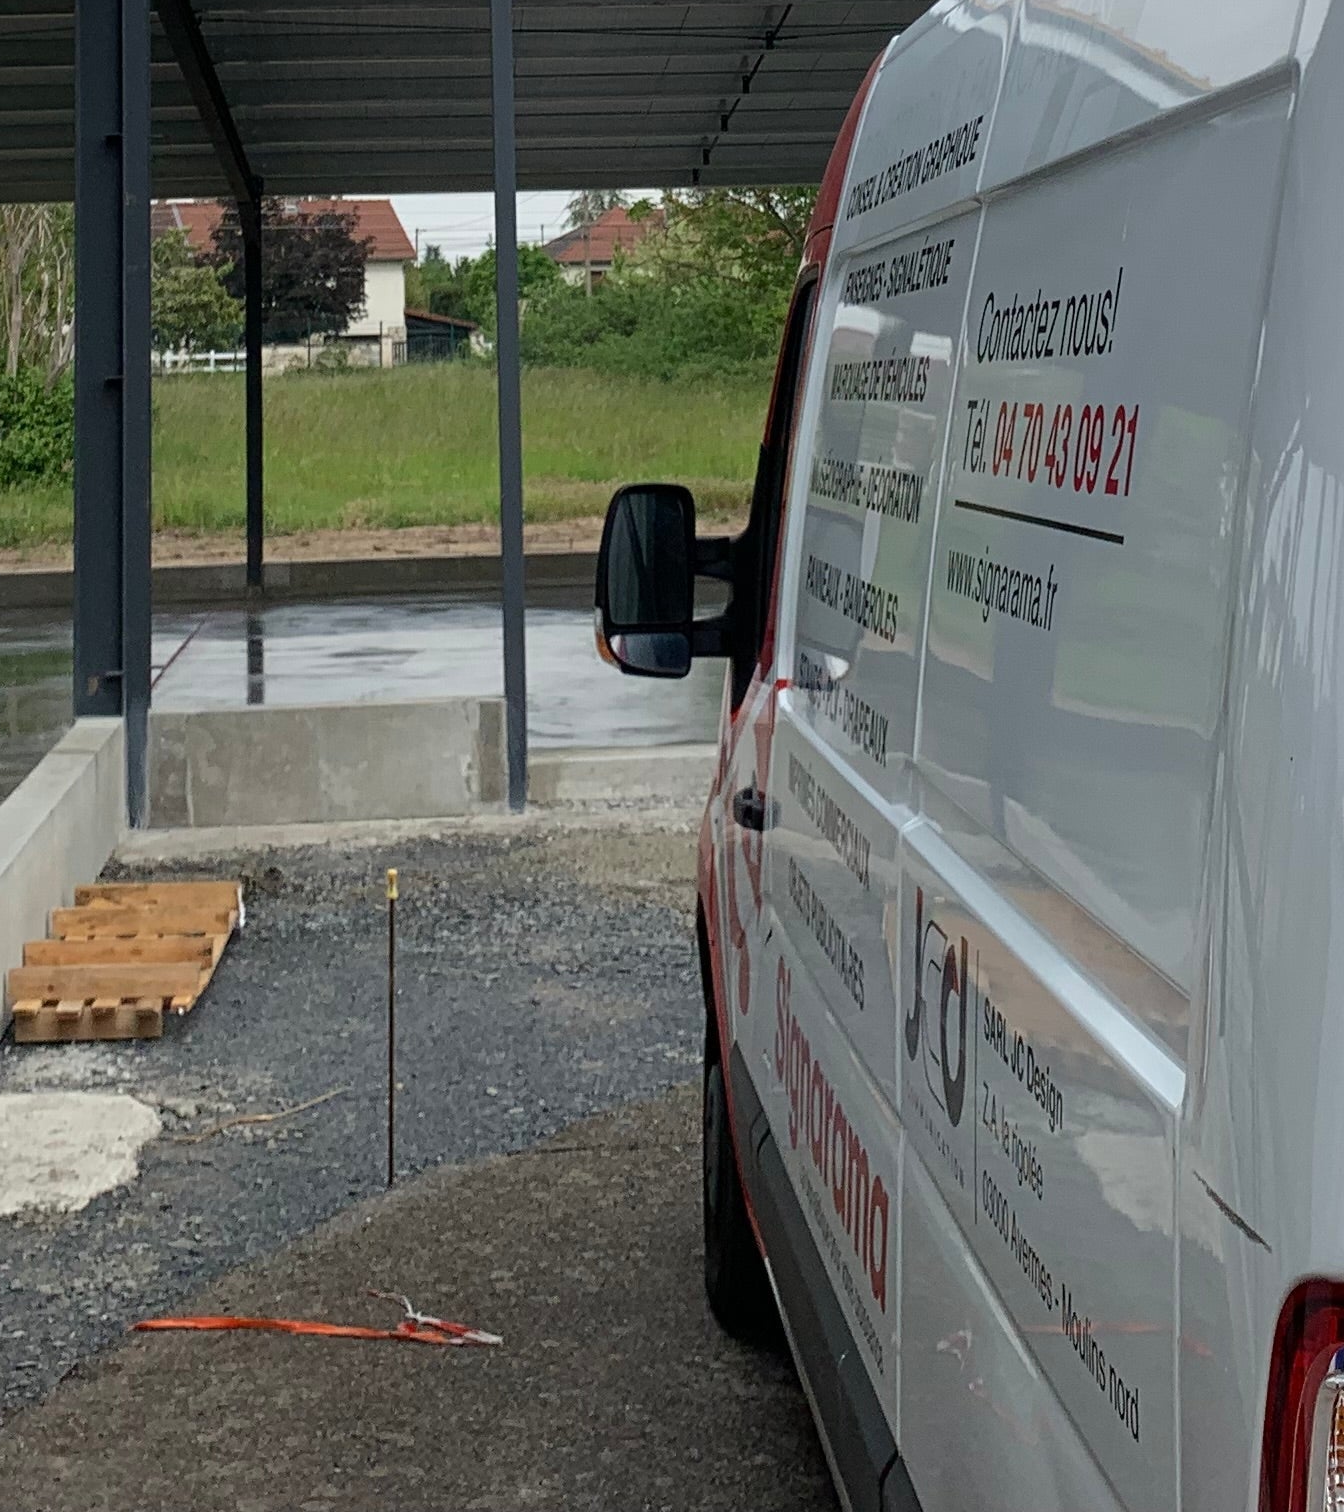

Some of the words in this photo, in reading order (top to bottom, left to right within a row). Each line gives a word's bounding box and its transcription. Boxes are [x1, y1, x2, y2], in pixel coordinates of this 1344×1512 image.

[878, 141, 927, 203] CRÉATION
[918, 114, 983, 185] GRAPHIQUE
[886, 235, 955, 298] SIGNALÉTIQUE
[977, 288, 1060, 364] Contactez
[1060, 266, 1123, 356] nous!
[867, 360, 882, 400] DE
[880, 350, 931, 401] VÉHICULES
[865, 461, 924, 525] DÉCORATION
[963, 398, 991, 473] Tél.
[992, 401, 1018, 477] 04
[1017, 402, 1043, 483] 70
[1044, 404, 1072, 489] 43
[1073, 404, 1105, 495] 09
[1104, 404, 1140, 497] 21
[843, 573, 898, 644] BANDEROLES
[946, 545, 1058, 631] www.signarama.fr
[984, 997, 1009, 1065] SARL
[1011, 1030, 1025, 1082] JC
[1027, 1046, 1063, 1133] Design
[775, 955, 889, 1315] Signarama
[1002, 1104, 1010, 1158] la
[1011, 1122, 1044, 1200] rigolée
[982, 1169, 1009, 1243] 03000
[1010, 1208, 1053, 1312] Avermes
[1061, 1282, 1106, 1393] Moulins
[1108, 1363, 1140, 1444] nord
